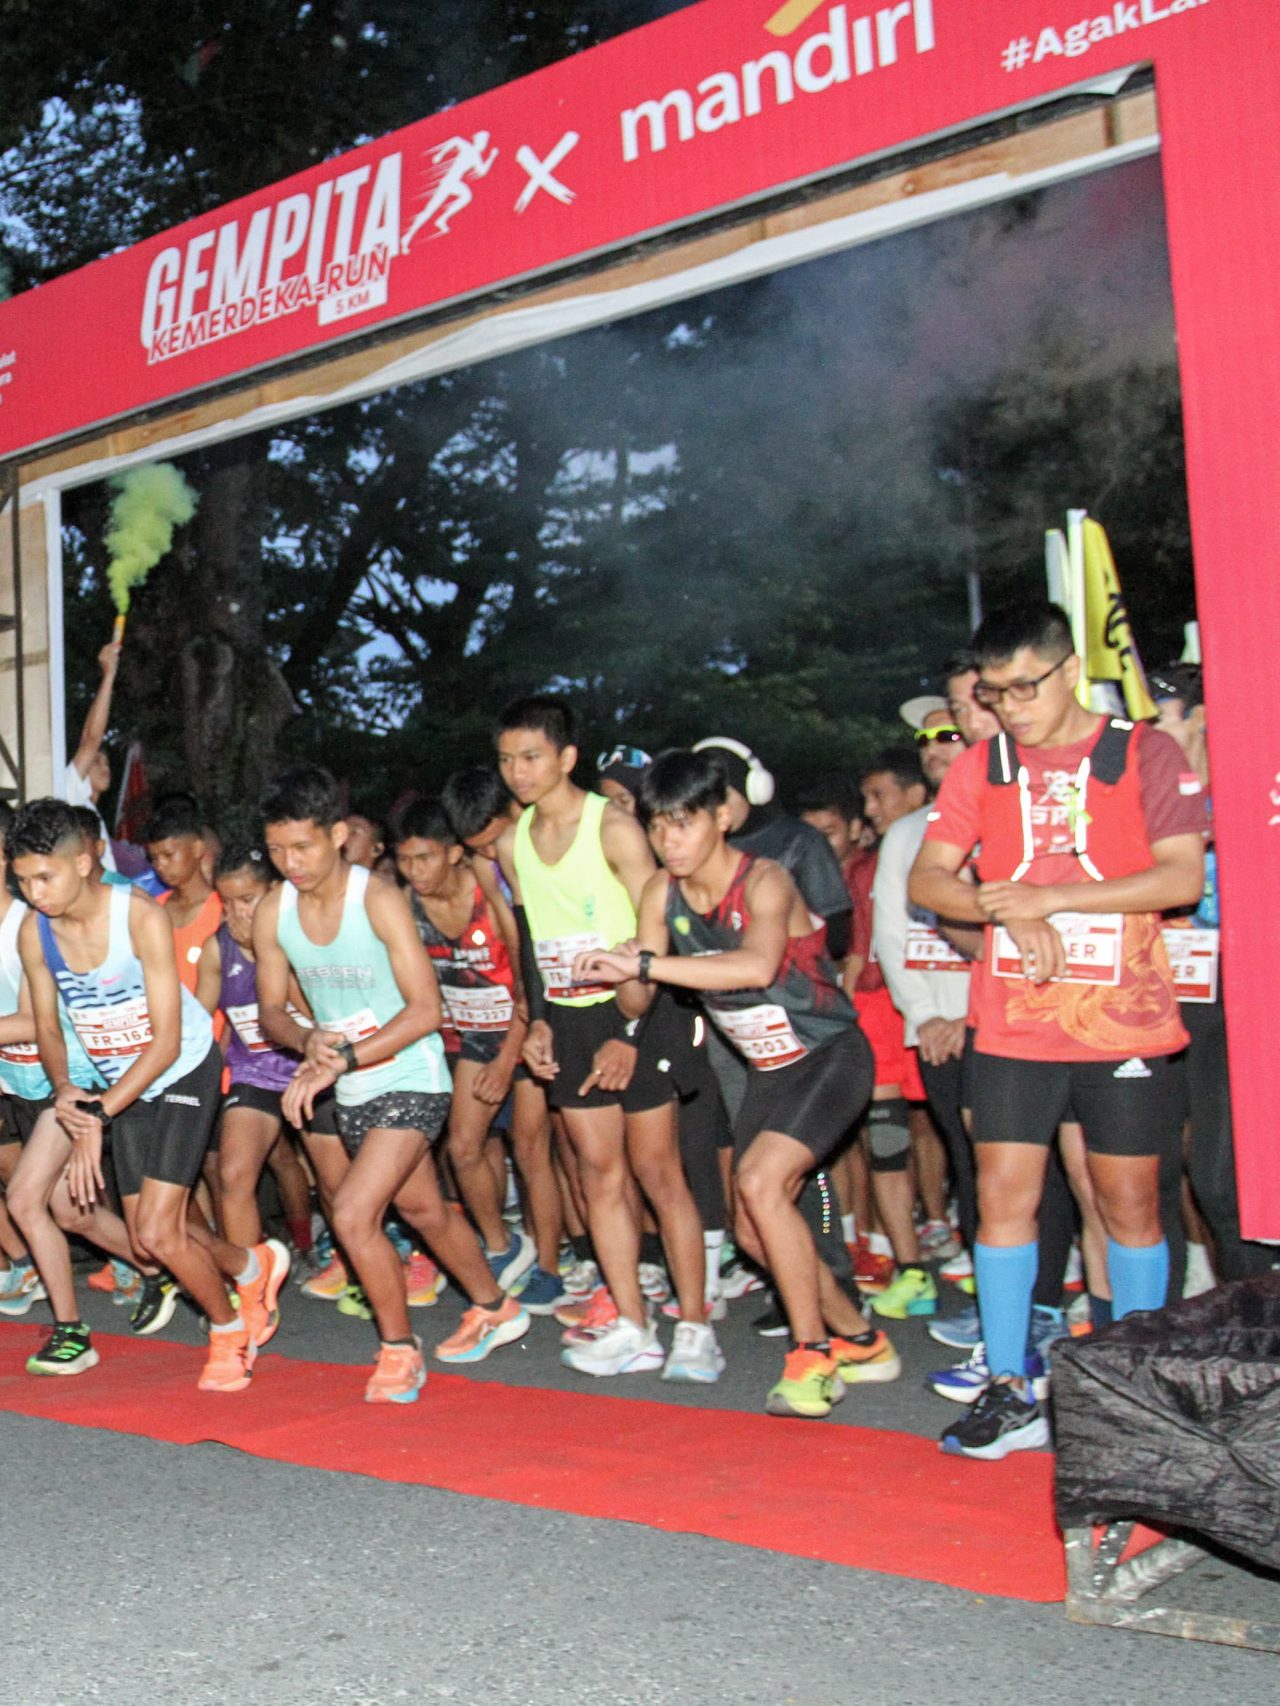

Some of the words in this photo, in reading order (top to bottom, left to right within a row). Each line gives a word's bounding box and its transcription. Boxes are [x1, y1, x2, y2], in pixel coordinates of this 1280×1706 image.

[621, 0, 935, 162] mandiri
[1001, 0, 1212, 72] #AgakLa
[141, 152, 402, 349] GEMPITA
[335, 301, 346, 315] 5
[347, 289, 370, 310] KM
